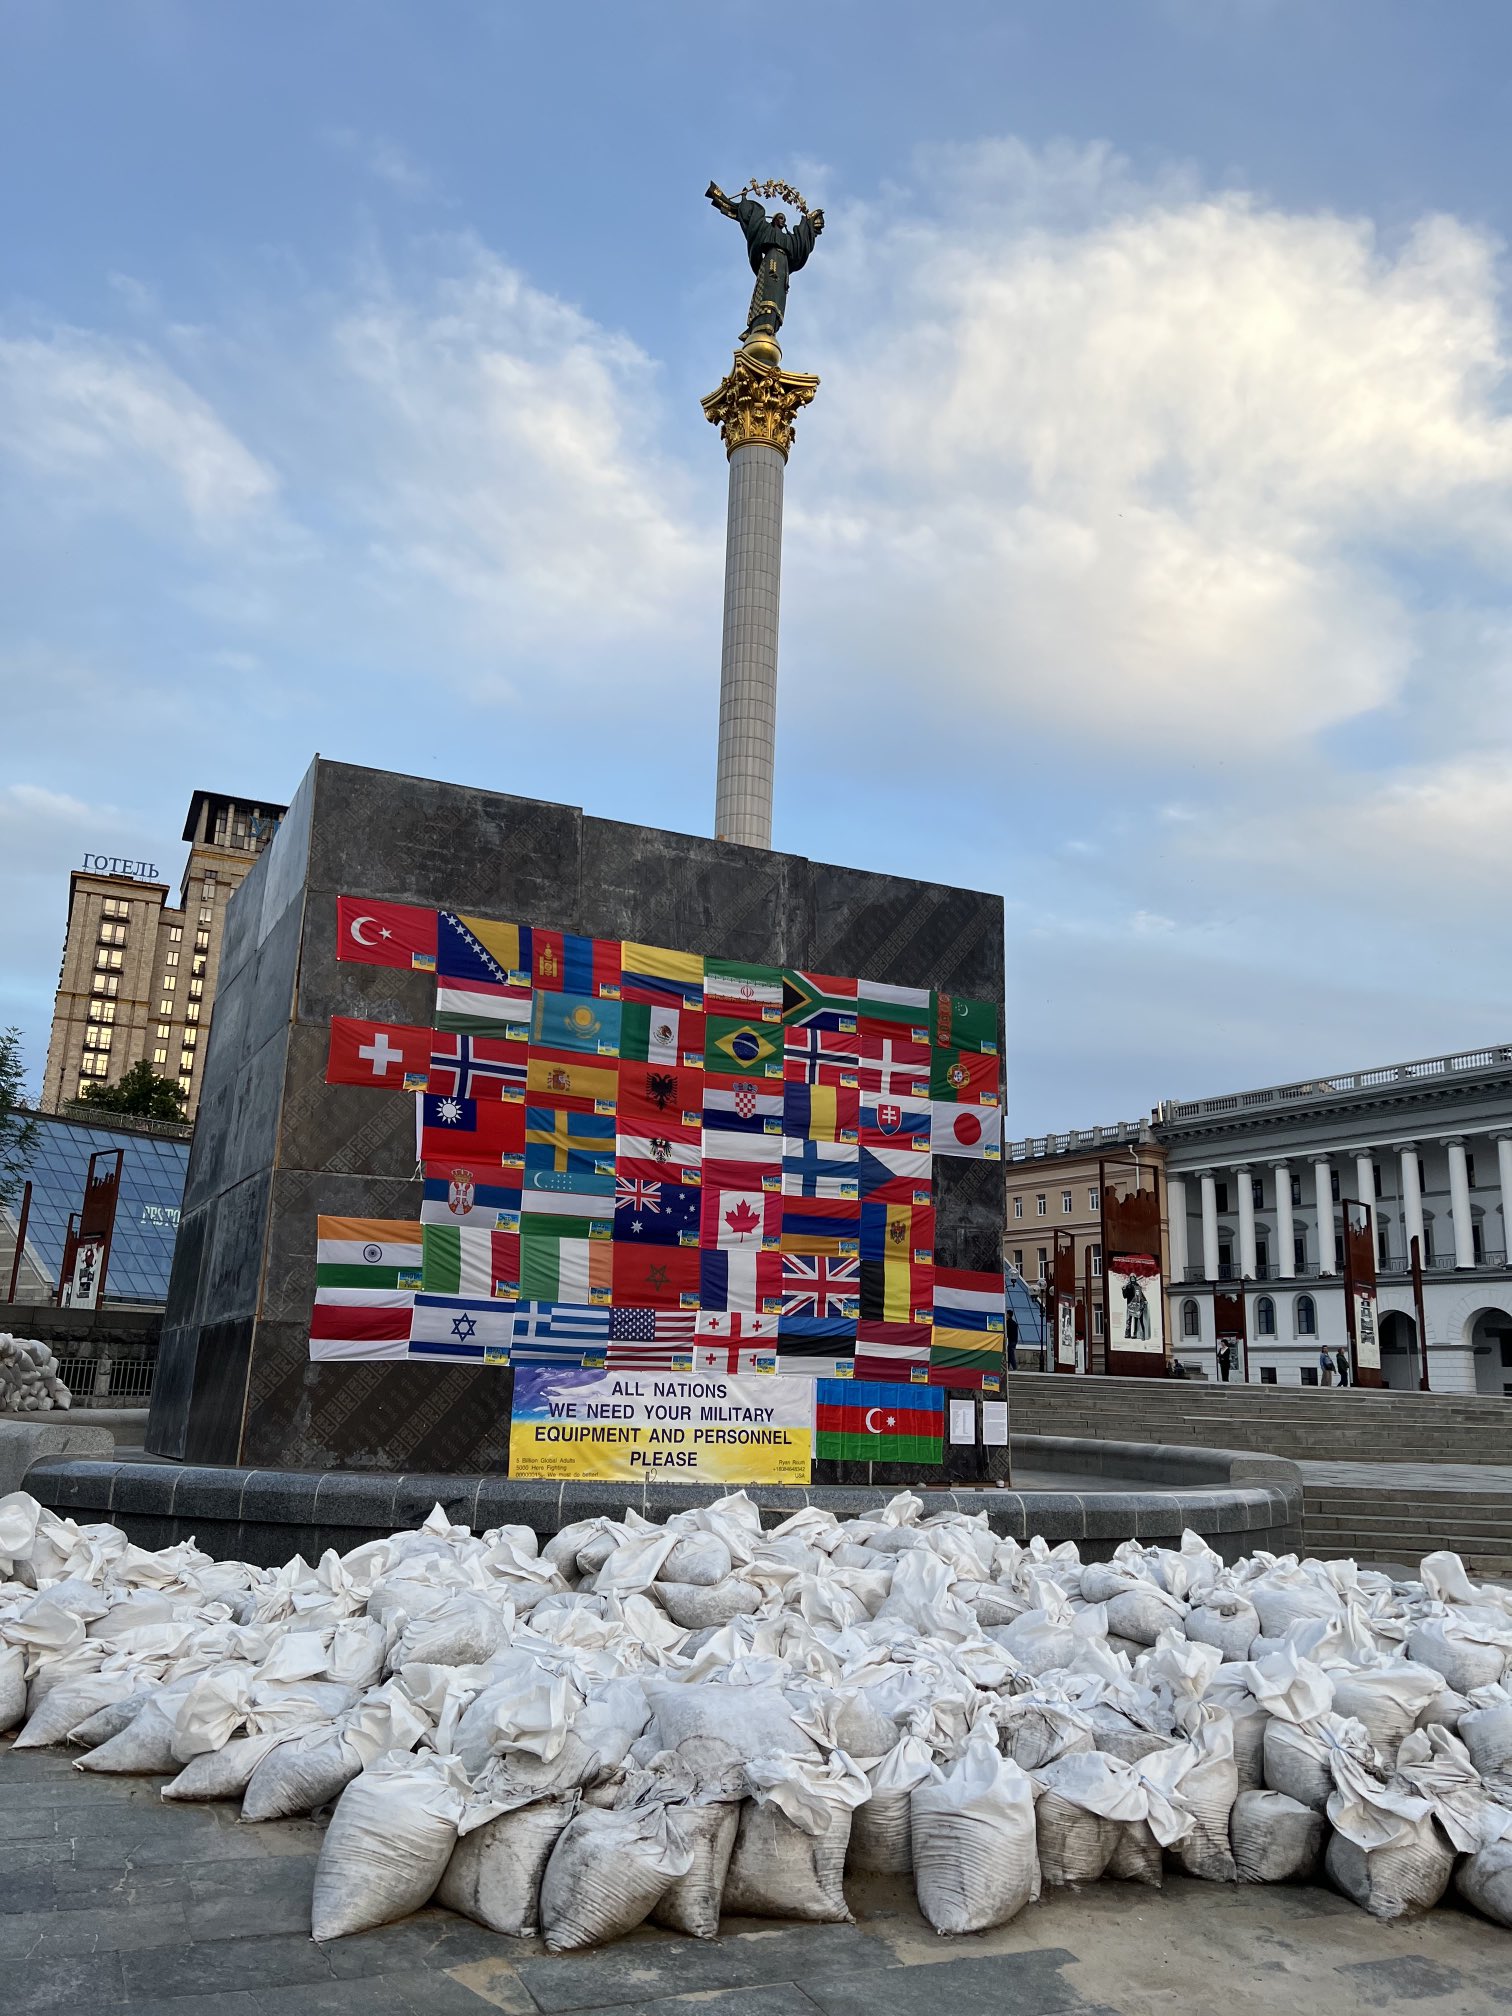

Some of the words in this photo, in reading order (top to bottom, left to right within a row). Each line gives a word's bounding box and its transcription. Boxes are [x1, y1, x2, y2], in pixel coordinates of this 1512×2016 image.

[82, 853, 159, 878] ГОТЕЛЬ
[611, 1381, 645, 1397] ALL
[653, 1382, 727, 1399] NATIONS
[548, 1402, 577, 1418] WE
[587, 1403, 635, 1419] NEED
[644, 1404, 691, 1421] YOUR
[700, 1406, 775, 1422] MILITARY
[535, 1426, 641, 1443] EQUIPMENT
[648, 1428, 685, 1444] AND
[693, 1429, 792, 1445] PERSONNEL
[630, 1451, 698, 1467] PLEASE
